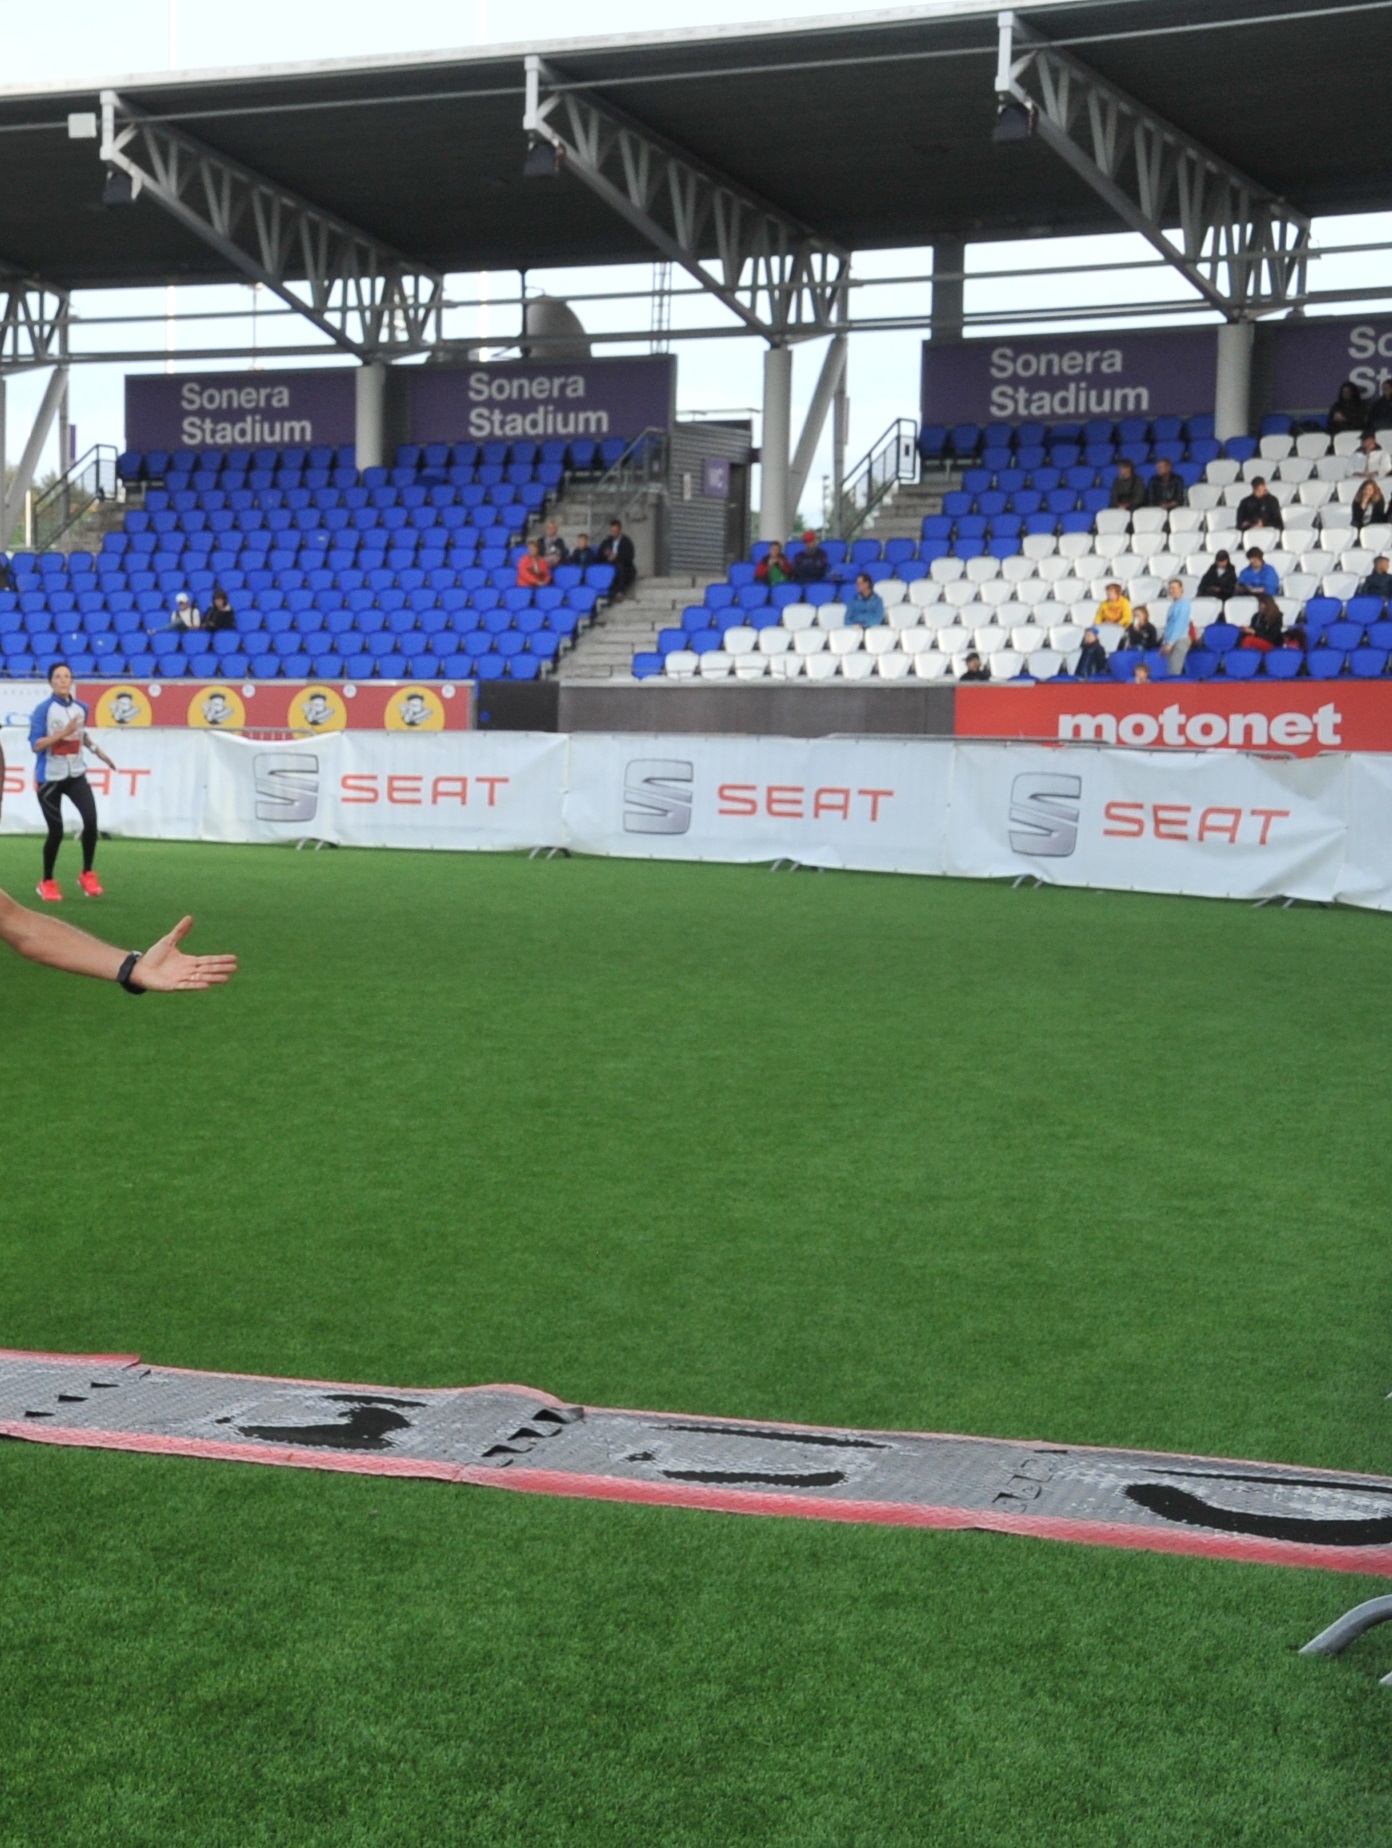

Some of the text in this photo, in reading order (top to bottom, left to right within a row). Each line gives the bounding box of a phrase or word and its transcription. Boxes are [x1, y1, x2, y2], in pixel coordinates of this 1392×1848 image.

[989, 347, 1123, 378] Sonera
[181, 383, 290, 410] Sonera
[468, 373, 585, 401] Sonera
[989, 382, 1149, 417] Stadium
[181, 415, 312, 446] Stadium
[468, 406, 609, 438] Stadium
[1058, 703, 1342, 746] motonet
[340, 774, 509, 807] SEAT
[717, 783, 894, 822] SEAT
[1102, 802, 1291, 845] SEAT
